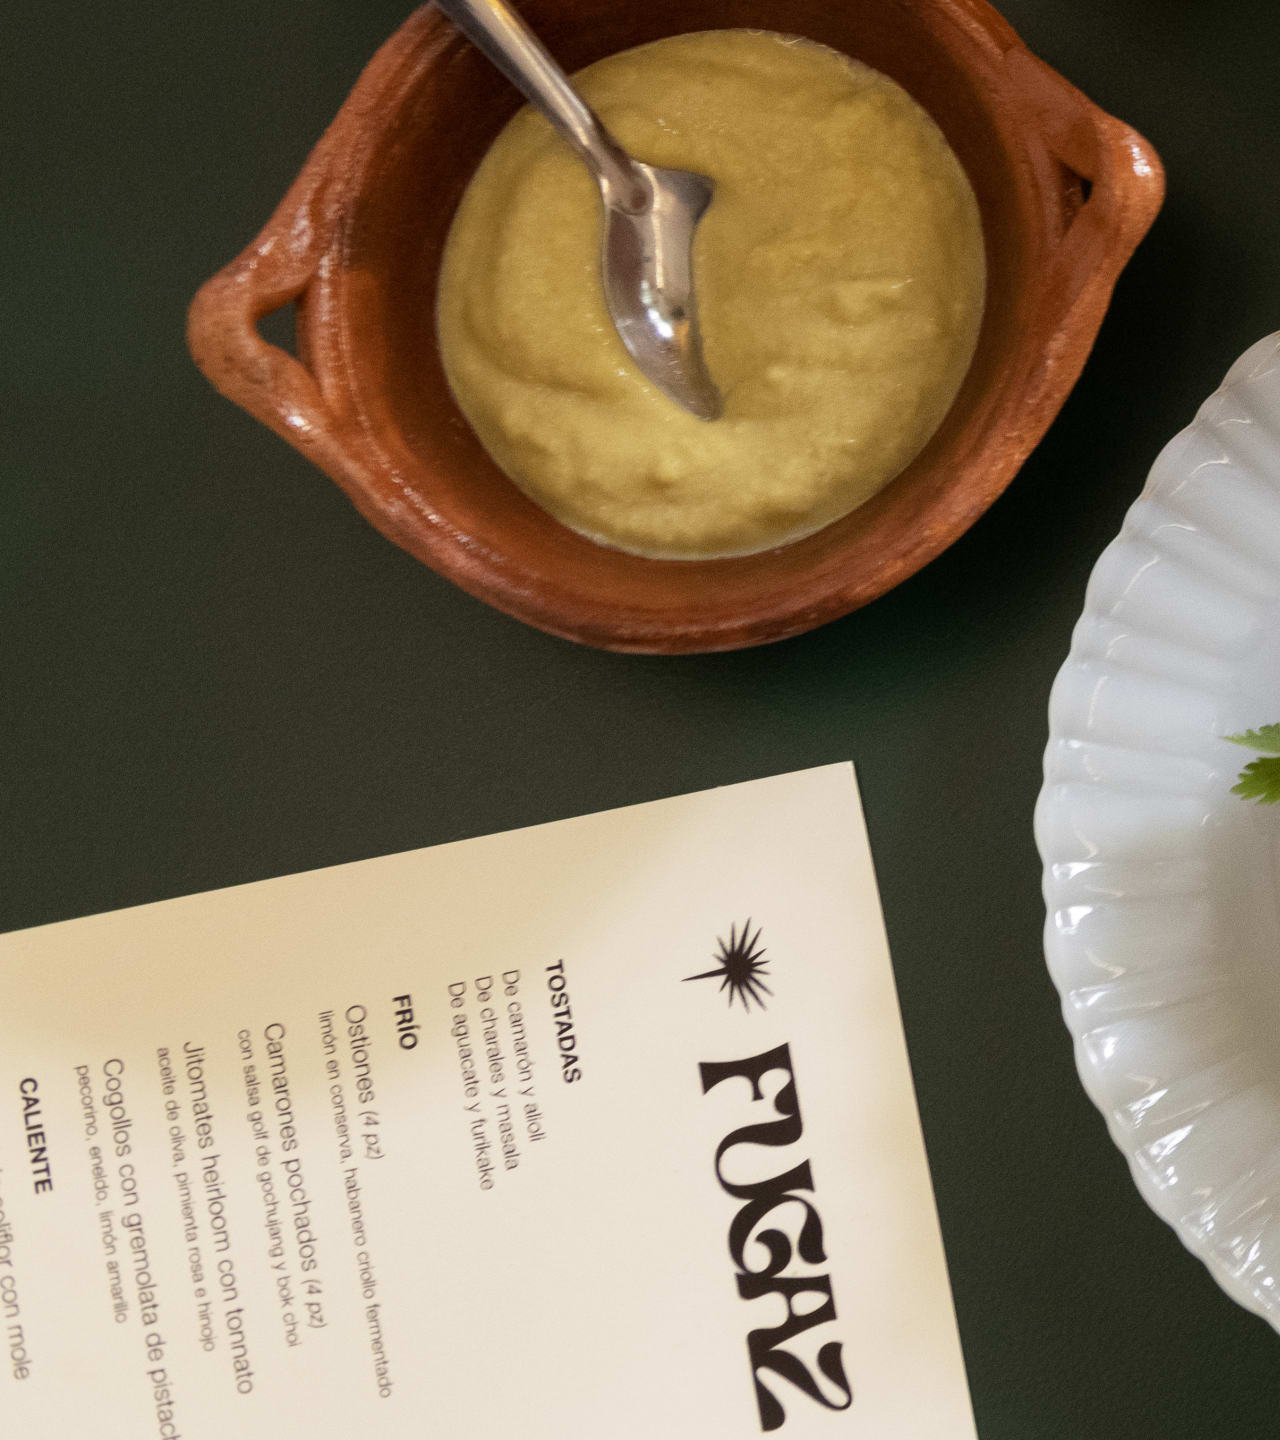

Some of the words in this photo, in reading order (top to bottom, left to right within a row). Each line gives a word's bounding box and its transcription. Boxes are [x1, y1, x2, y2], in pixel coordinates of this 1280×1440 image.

[446, 980, 467, 1009] De
[473, 974, 493, 1002] De
[500, 968, 520, 997] De
[317, 1009, 337, 1056] limón
[391, 993, 421, 1051] FRÍO
[506, 1000, 534, 1082] camarón
[544, 957, 583, 1084] TOSTADAS
[237, 1028, 253, 1061] con
[344, 1003, 375, 1104] Ostiones
[450, 1013, 480, 1098] aguacate
[479, 1006, 505, 1084] charales
[156, 1046, 176, 1095] aceite
[242, 1063, 261, 1107] salsa
[263, 1021, 298, 1152] Camarones
[325, 1058, 340, 1080] en
[489, 1086, 507, 1099] y
[517, 1084, 534, 1098] y
[73, 1063, 98, 1141] pecorino,
[101, 1057, 132, 1157] Cogollos
[164, 1099, 181, 1121] de
[182, 1040, 214, 1149] Jitomates
[357, 1109, 380, 1126] (4
[463, 1100, 481, 1114] y
[18, 1076, 54, 1195] CALIENTE
[246, 1109, 269, 1140] golf
[329, 1083, 353, 1164] conserva,
[495, 1103, 521, 1171] masala
[523, 1102, 546, 1142] alioli
[168, 1125, 185, 1167] oliva,
[255, 1144, 271, 1166] de
[360, 1132, 385, 1160] pz)
[470, 1117, 495, 1190] furikake
[117, 1162, 139, 1206] con
[172, 1171, 199, 1243] pimienta
[200, 1153, 230, 1253] heirloom
[343, 1166, 366, 1247] habanero
[98, 1209, 117, 1256] limón
[255, 1170, 284, 1258] gochujang
[279, 1157, 317, 1272] pochados
[698, 1042, 853, 1431] FUGAZ
[120, 1212, 159, 1326] gremolata
[188, 1245, 204, 1283] rosa
[216, 1258, 238, 1302] con
[271, 1260, 286, 1271] y
[300, 1278, 323, 1295] (4
[356, 1250, 376, 1299] criollo
[0, 1274, 20, 1318] con
[105, 1260, 128, 1323] amarillo
[194, 1285, 206, 1299] e
[276, 1274, 294, 1308] bok
[197, 1301, 215, 1352] hinojo
[282, 1311, 298, 1347] choi
[303, 1301, 327, 1329] pz)
[7, 1324, 32, 1381] mole
[144, 1331, 166, 1362] de
[224, 1306, 254, 1394] tonnato
[365, 1302, 392, 1398] fermentado
